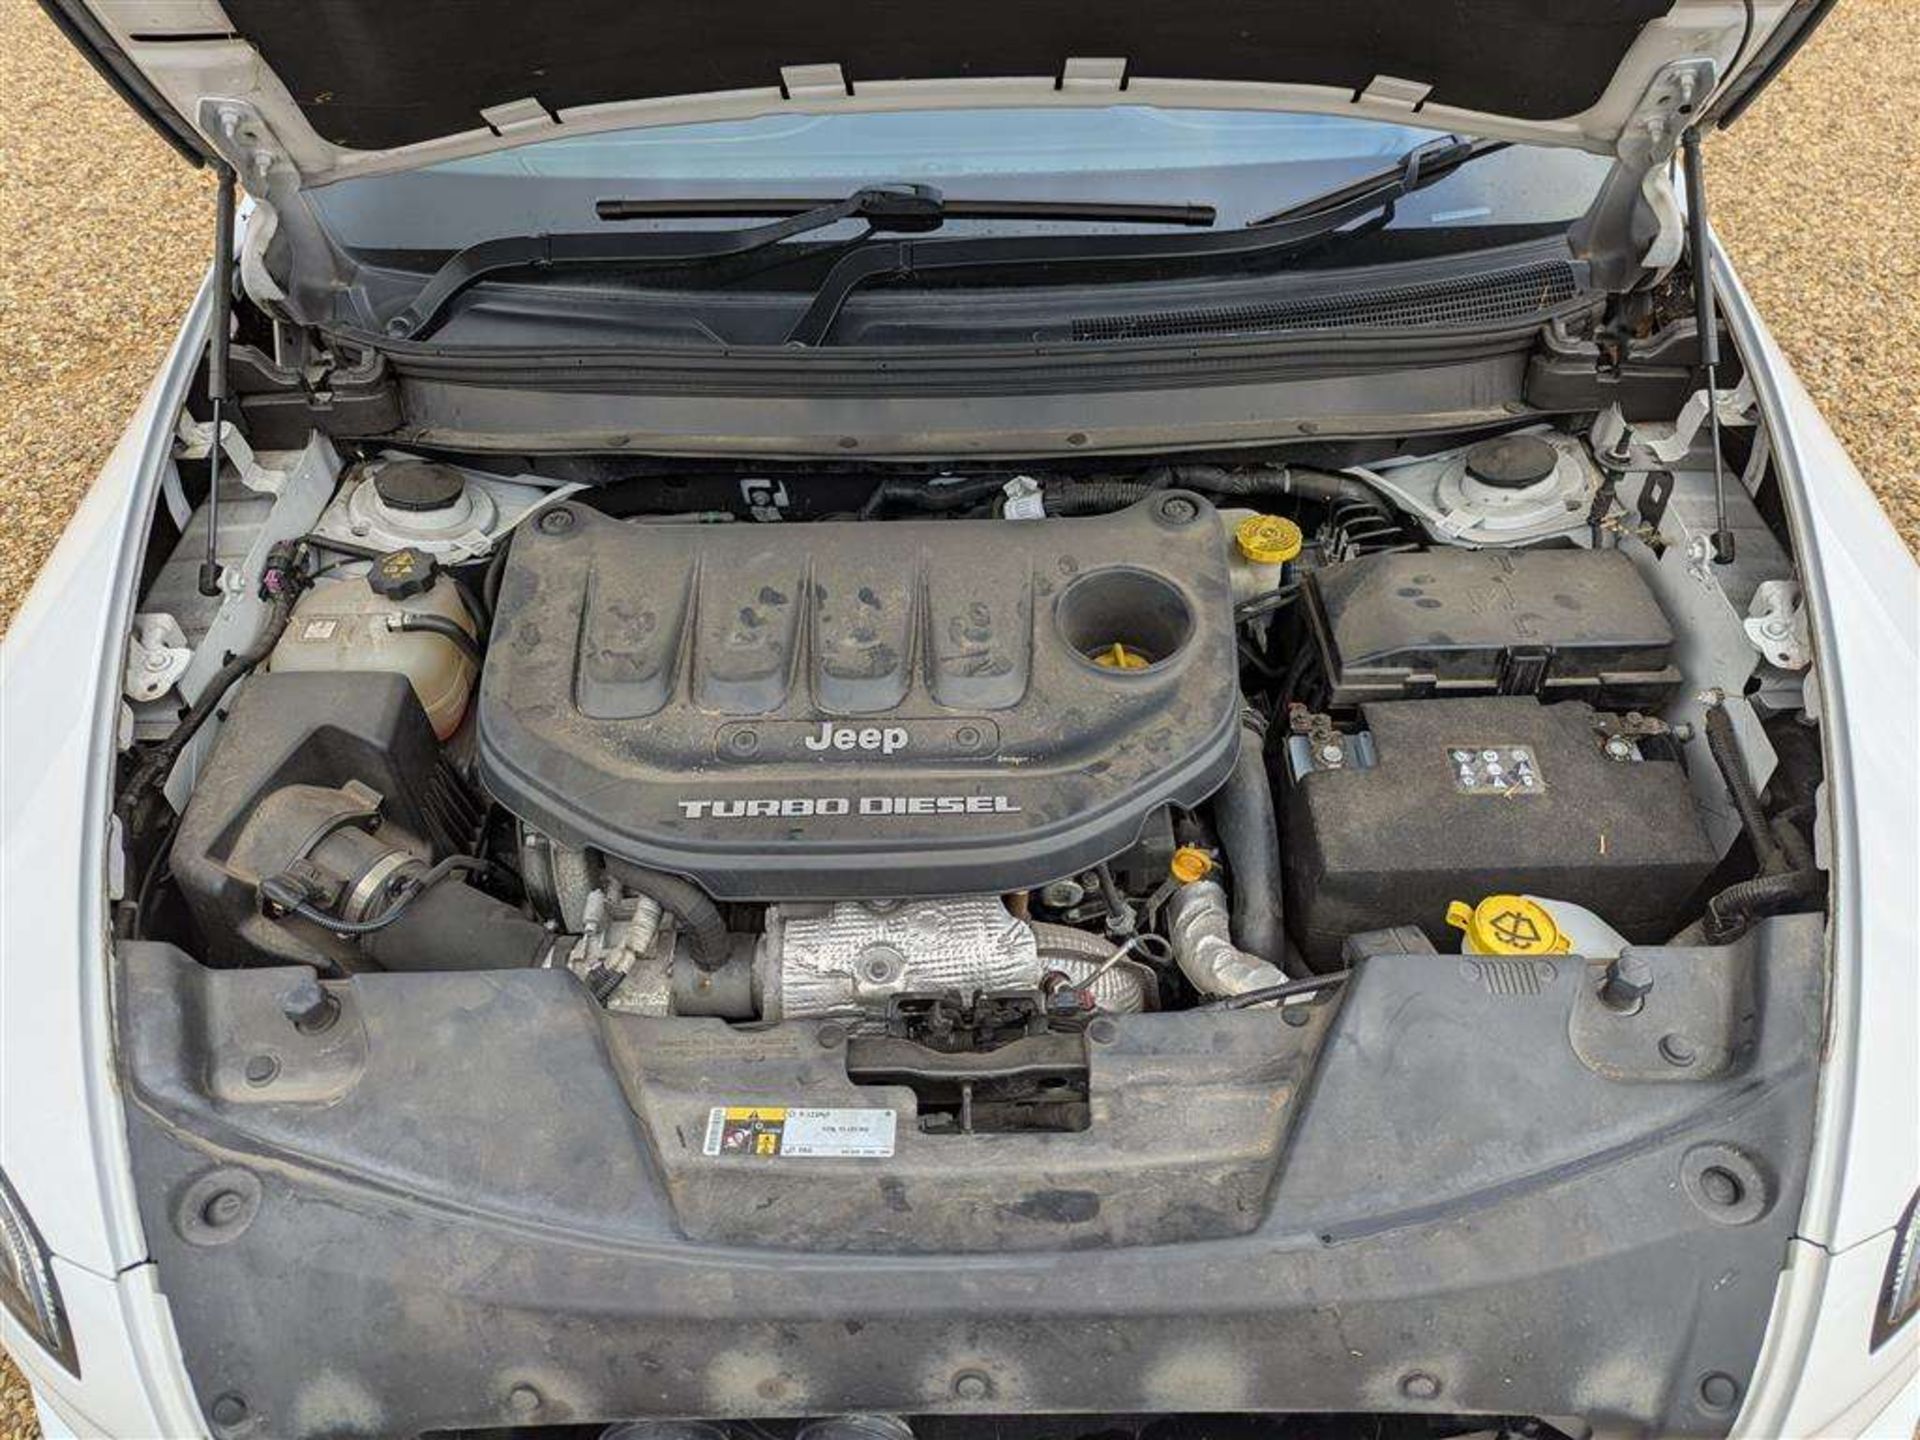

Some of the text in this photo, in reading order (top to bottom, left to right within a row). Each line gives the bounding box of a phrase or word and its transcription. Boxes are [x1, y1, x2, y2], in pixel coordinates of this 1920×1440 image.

[805, 722, 908, 754] Jeep
[678, 796, 1022, 818] TURBO DIESEL
